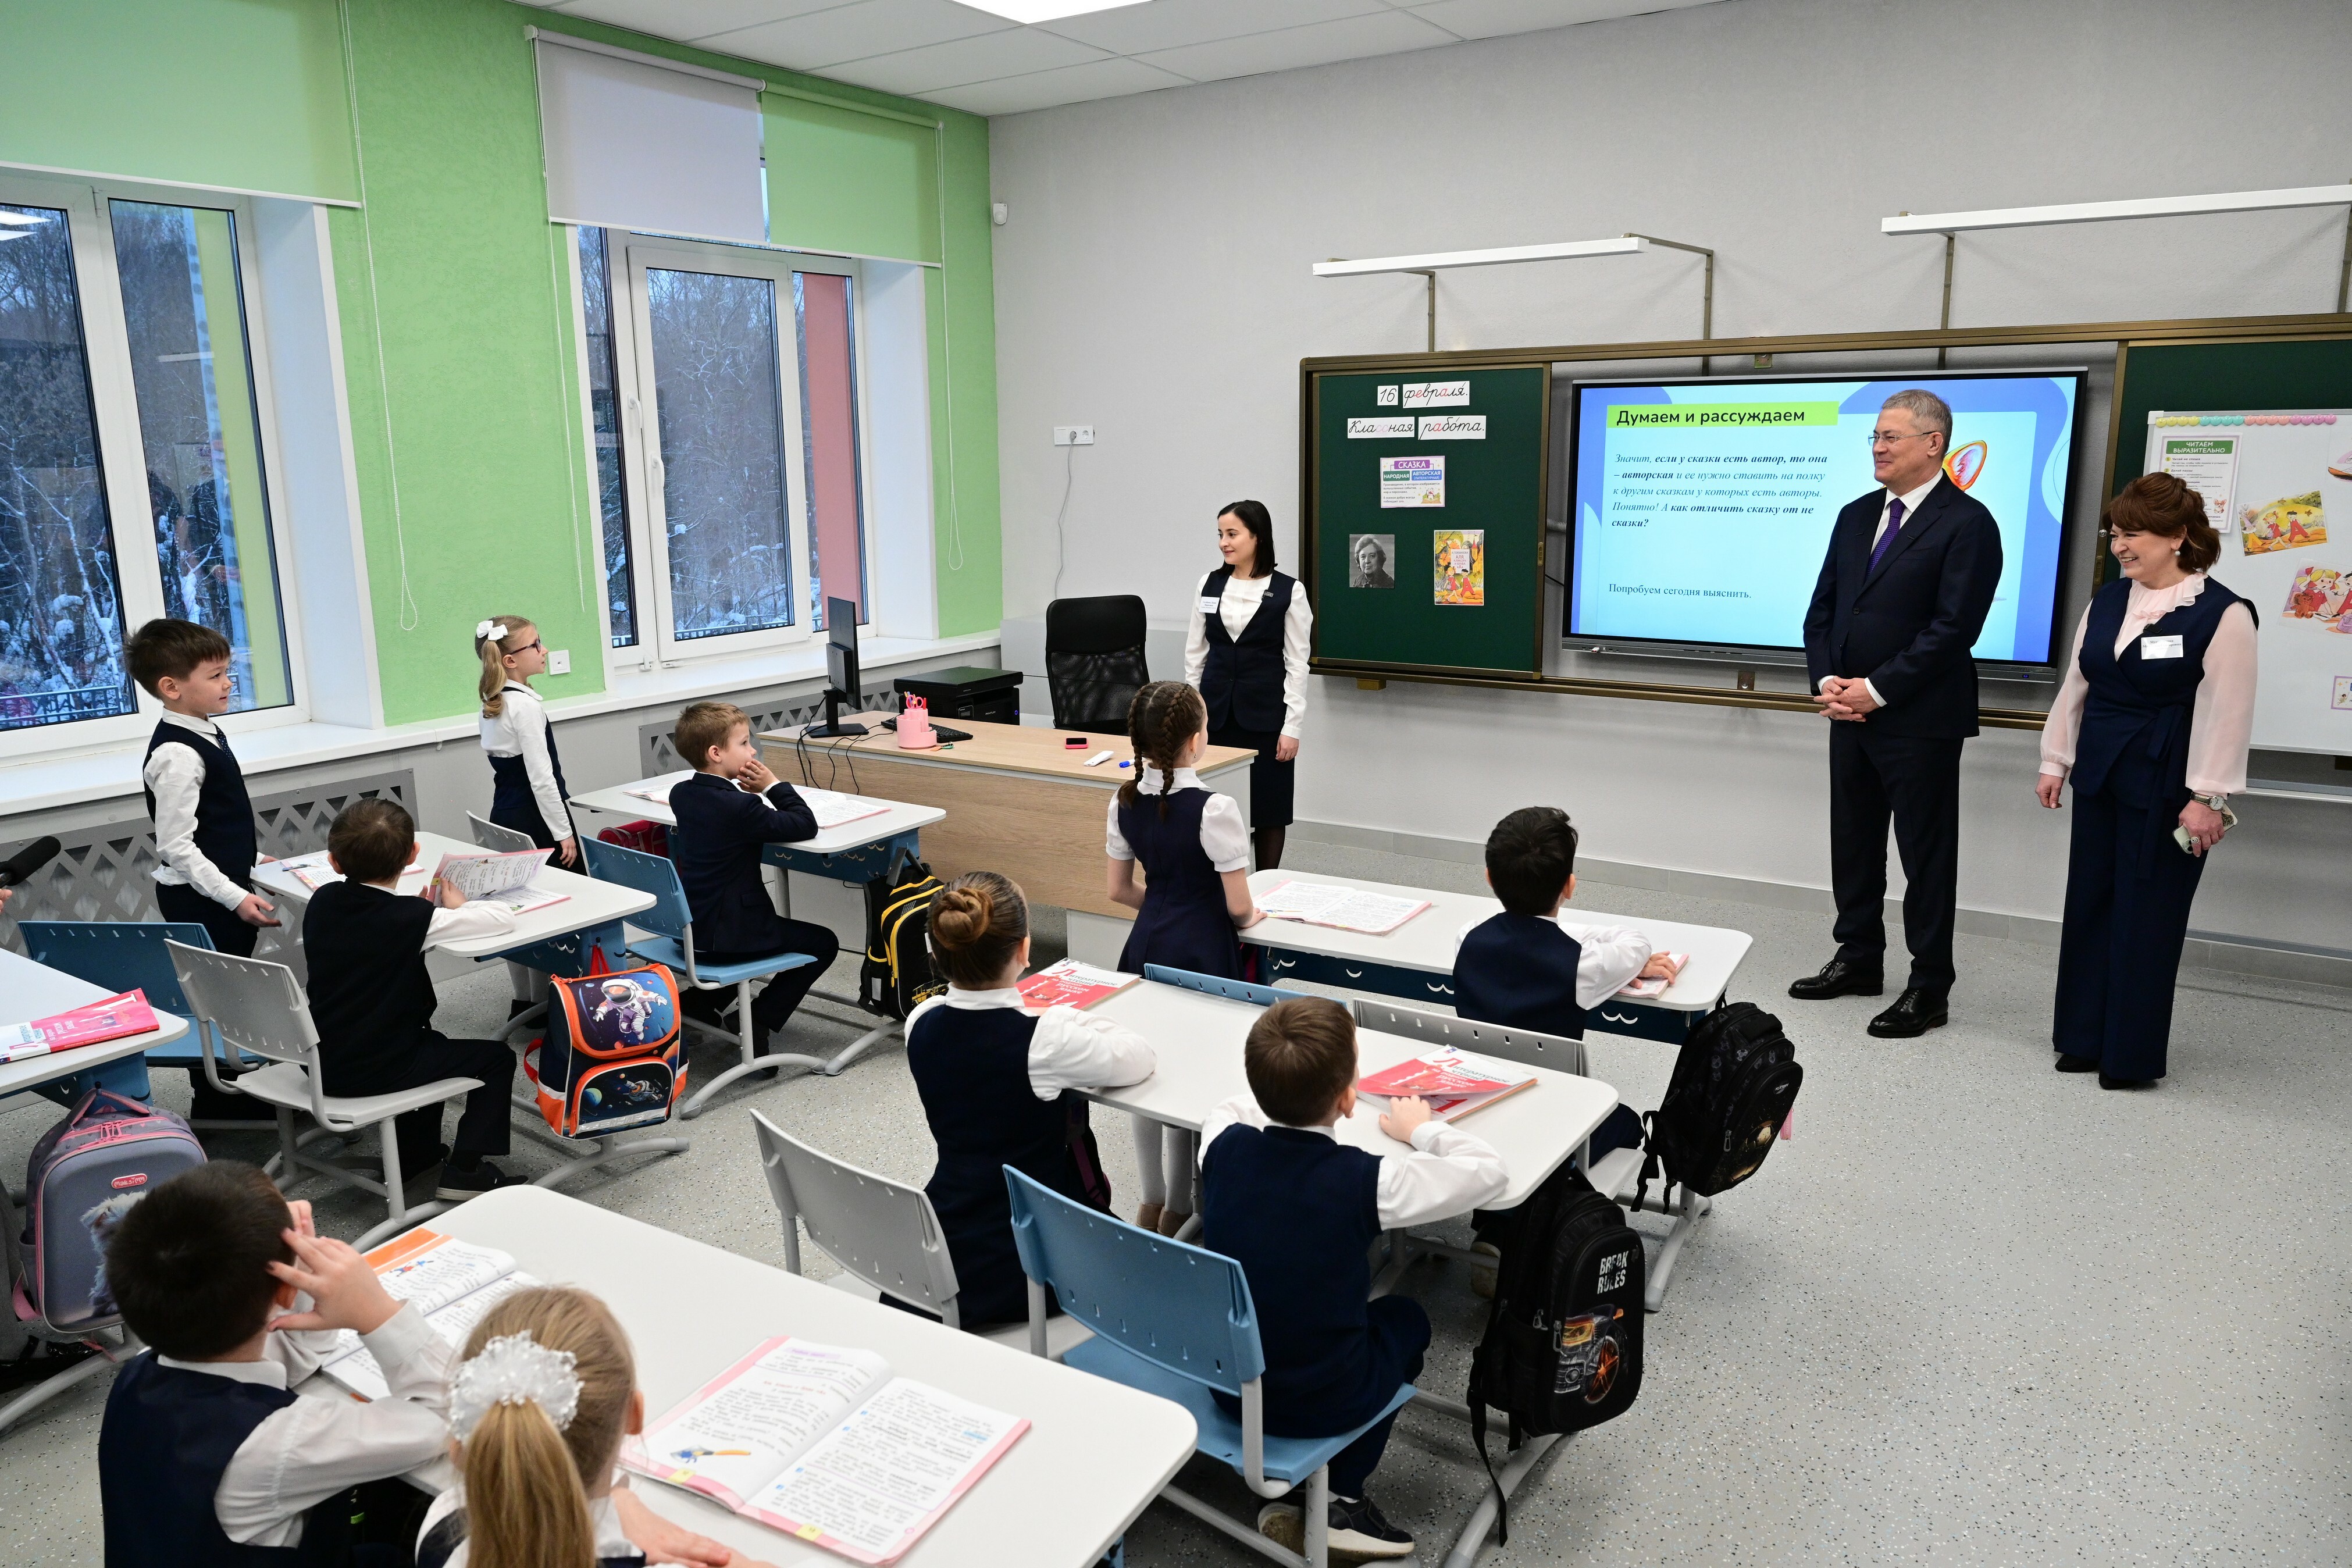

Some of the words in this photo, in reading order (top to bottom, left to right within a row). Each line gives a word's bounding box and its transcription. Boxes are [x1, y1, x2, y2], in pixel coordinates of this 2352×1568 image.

[1380, 388, 1397, 402] 16
[1616, 410, 1680, 426] Думаем
[1685, 413, 1695, 423] и
[1700, 411, 1805, 426] рассуждаем
[1615, 454, 1652, 464] Значит,
[1679, 456, 1685, 465] у
[1751, 456, 1786, 465] автор,
[1622, 472, 1674, 481] авторская
[1697, 473, 1731, 482] нужно
[1795, 473, 1826, 483] полку
[1621, 487, 1653, 497] другим
[1695, 489, 1703, 498] у
[1705, 490, 1749, 498] которых
[1779, 490, 1822, 500] авторы.
[1612, 502, 1659, 511] Понятно!
[1660, 503, 1668, 511] А
[1747, 507, 1780, 516] сказку
[1612, 519, 1649, 527] сказки?
[1609, 583, 1660, 596] Попробуем
[1663, 588, 1700, 596] сегодня
[1703, 590, 1751, 598] выяснить.
[1052, 969, 1117, 986] Литературное
[1055, 982, 1089, 992] русском
[93, 993, 137, 1011] 1
[1433, 1058, 1510, 1082] Литературное
[1452, 1070, 1482, 1080] чтение
[1435, 1075, 1476, 1086] русском
[1599, 1251, 1628, 1275] BREAK
[1597, 1269, 1626, 1294] RULES
